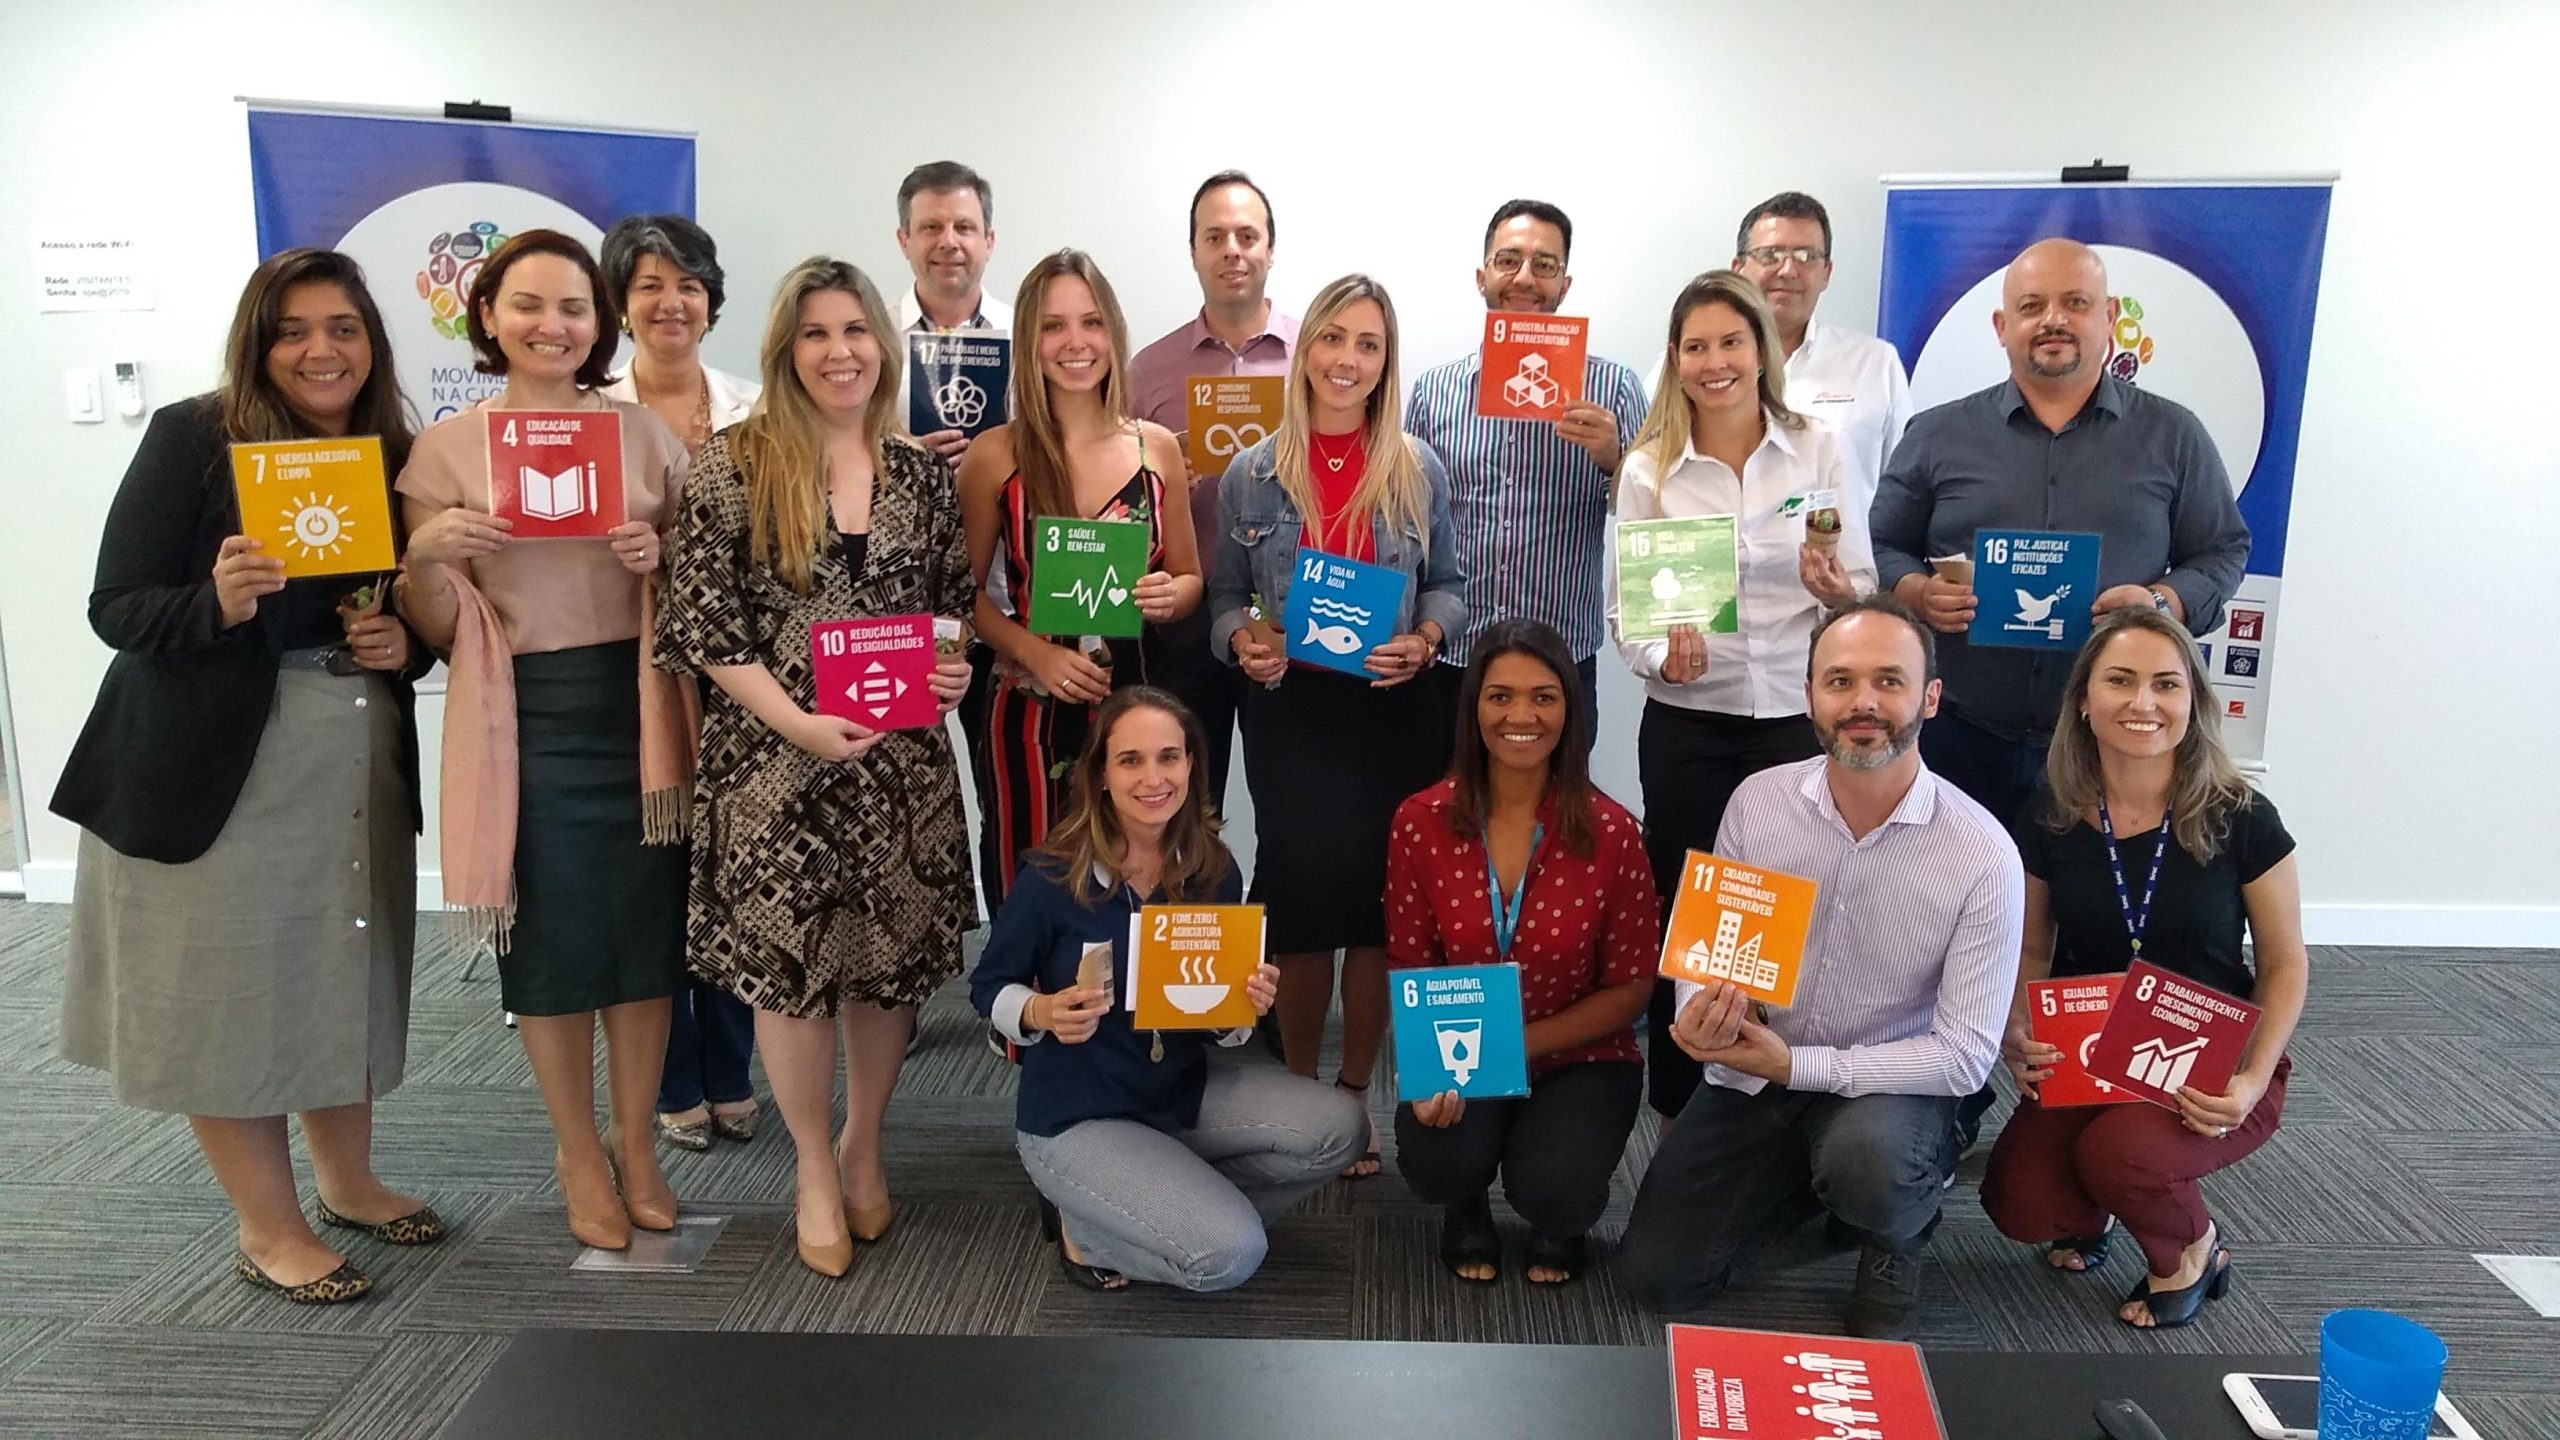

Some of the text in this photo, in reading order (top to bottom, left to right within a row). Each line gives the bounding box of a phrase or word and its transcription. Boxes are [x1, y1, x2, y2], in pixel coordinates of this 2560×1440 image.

[1493, 319, 1507, 344] 9
[919, 341, 937, 365] 17
[1193, 383, 1212, 406] 12
[502, 419, 519, 447] 4
[526, 418, 583, 432] EDUCAÇÃO DE
[527, 433, 573, 446] QUALIDADE
[251, 453, 266, 484] 7
[1047, 526, 1060, 552] 3
[1068, 528, 1091, 540] SAÚDE
[1628, 531, 1650, 557] 15
[2031, 540, 2064, 551] JUSTIÇA
[2064, 541, 2070, 551] E
[1067, 541, 1106, 553] BEM-ESTAR
[1985, 538, 2008, 564] 16
[2012, 551, 2063, 564] INSTITUIÇÕES
[1302, 558, 1325, 583] 14
[1329, 565, 1356, 580] VIDA NA
[2011, 564, 2047, 575] EFICAZES
[1326, 575, 1345, 590] ÁGUA
[820, 630, 845, 657] 10
[850, 624, 913, 640] REDUÇÃO DAS
[851, 637, 924, 654] DESIGUALDADES
[1694, 863, 1715, 893] 11
[1722, 866, 1763, 886] CIDADES E
[1720, 880, 1777, 903] COMUNIDADES
[1716, 893, 1774, 917] SUSTENTÁVEIS
[1154, 914, 1168, 941] 2
[1172, 913, 1218, 924] FOME ZERO E
[1171, 926, 1222, 938] AGRICULTURA
[1170, 939, 1221, 951] SUSTENTÁVEL
[1403, 979, 1419, 1008] 6
[1426, 977, 1481, 992] ÁGUA POTÁVEL
[2062, 986, 2108, 1000] IGUALDADE
[2136, 975, 2156, 1001] 8
[1427, 992, 1484, 1006] E SANEAMENTO
[2041, 989, 2057, 1016] 5
[2064, 999, 2108, 1013] DE GÊNERO
[2157, 994, 2213, 1023] CRESCIMENTO
[2163, 980, 2247, 1023] TRABALHO DECENTE E
[1692, 1368, 1720, 1428] ERRADICAÇÃO
[1722, 1378, 1748, 1432] DA POBREZA
